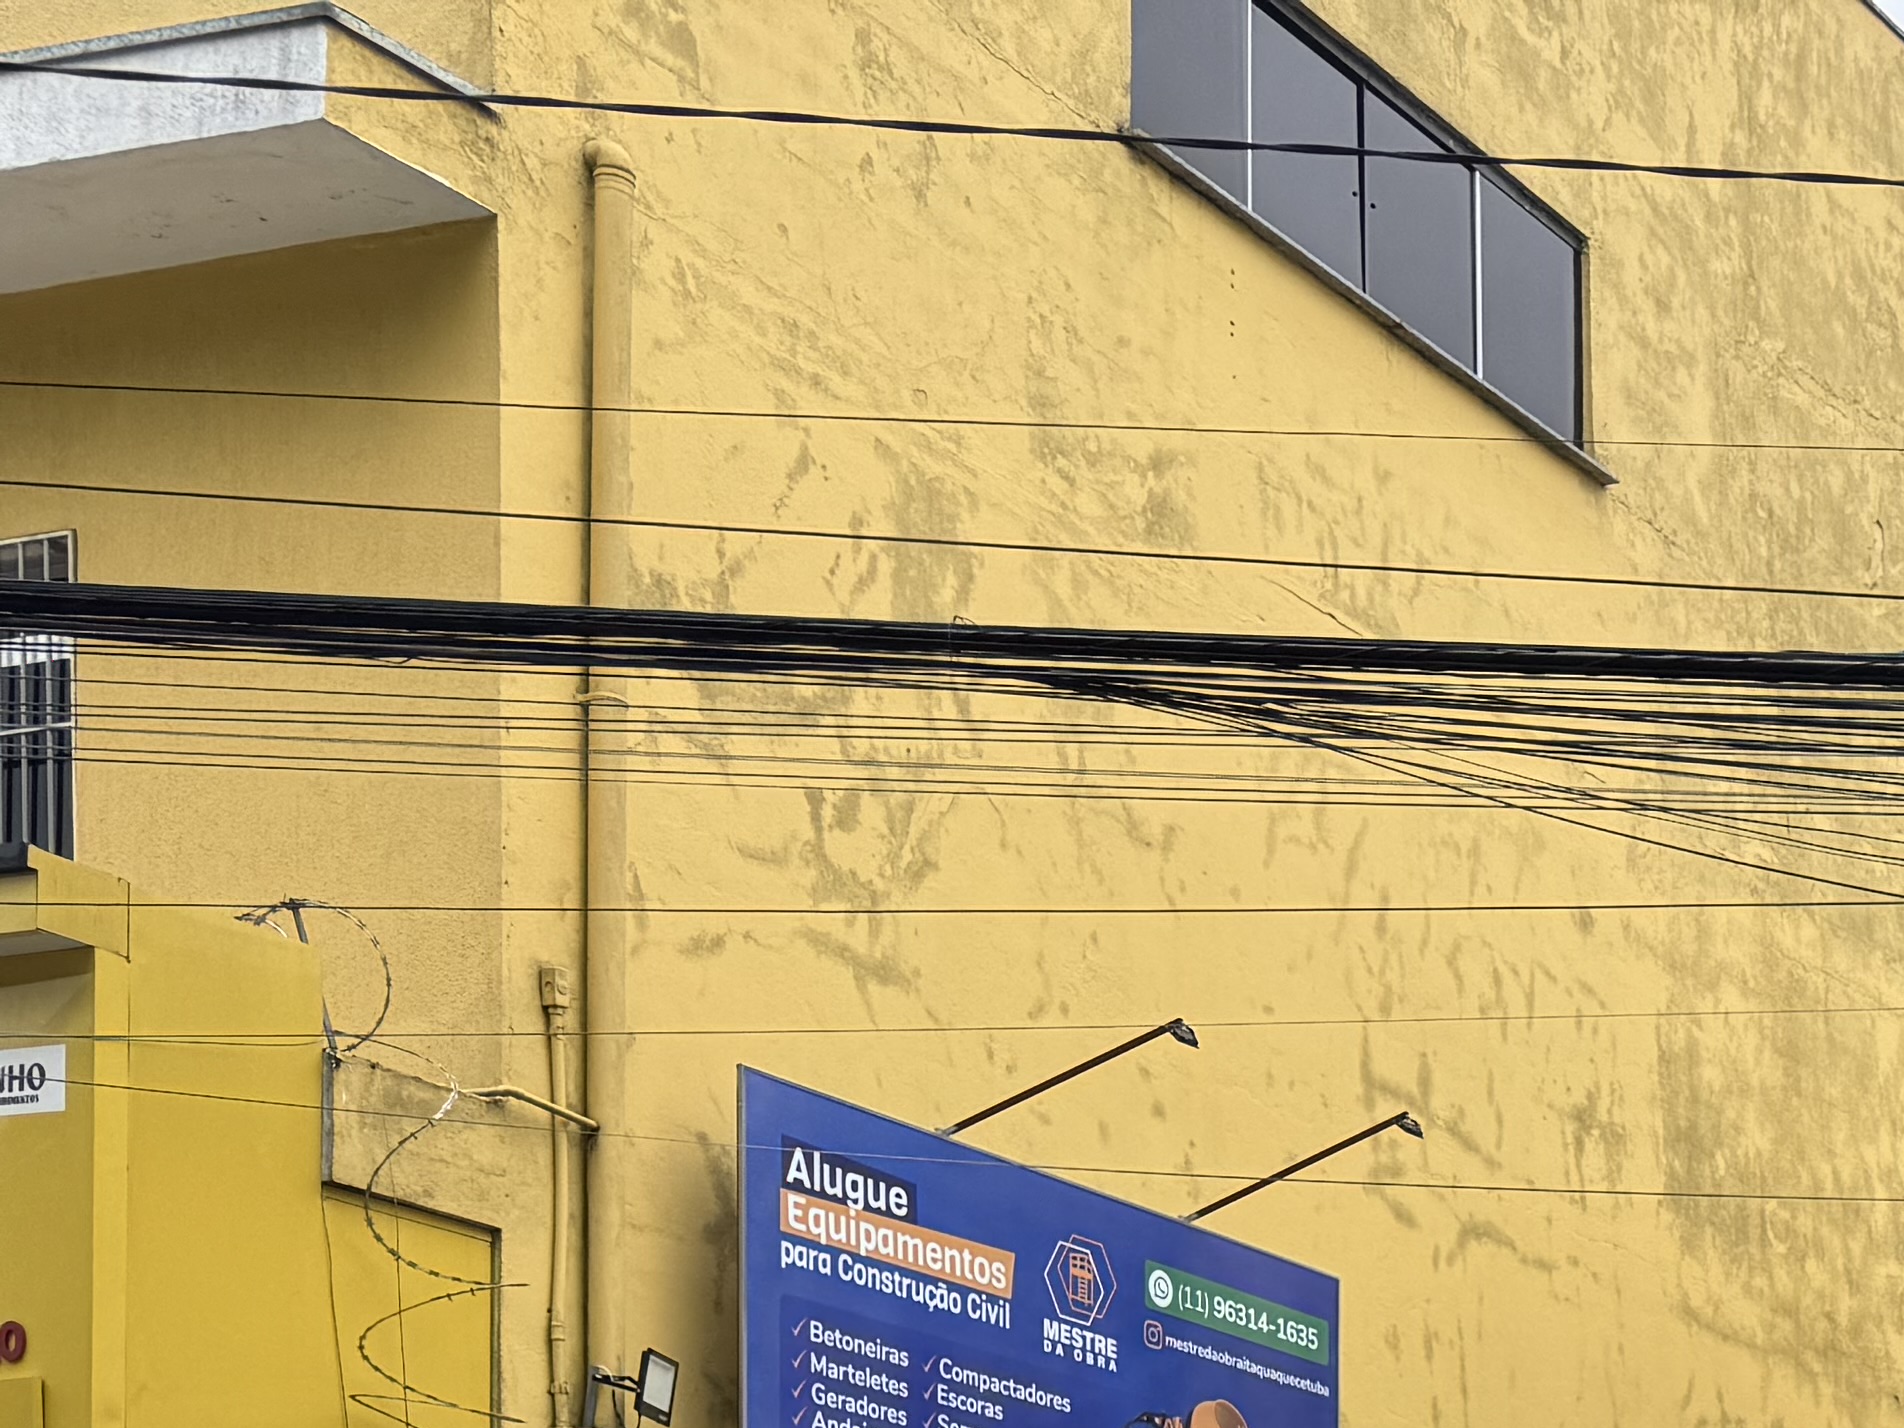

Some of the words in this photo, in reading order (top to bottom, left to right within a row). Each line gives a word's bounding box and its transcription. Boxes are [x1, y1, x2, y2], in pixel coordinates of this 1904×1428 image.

[786, 1147, 908, 1217] Alugue
[787, 1193, 1007, 1289] Equipamentos
[780, 1240, 831, 1276] para
[838, 1253, 961, 1314] Construção
[967, 1293, 1011, 1329] Civil
[1043, 1318, 1118, 1360] MESTRE
[1178, 1284, 1210, 1319] (11)
[1213, 1296, 1319, 1350] 96314-1635
[809, 1320, 909, 1367] Betoneiras
[1043, 1339, 1064, 1357] DA
[1074, 1348, 1118, 1373] OBRA
[810, 1352, 909, 1398] Marteletes
[939, 1358, 1072, 1413] Compactadores
[811, 1382, 907, 1426] Geradores
[937, 1383, 1004, 1420] Escoras
